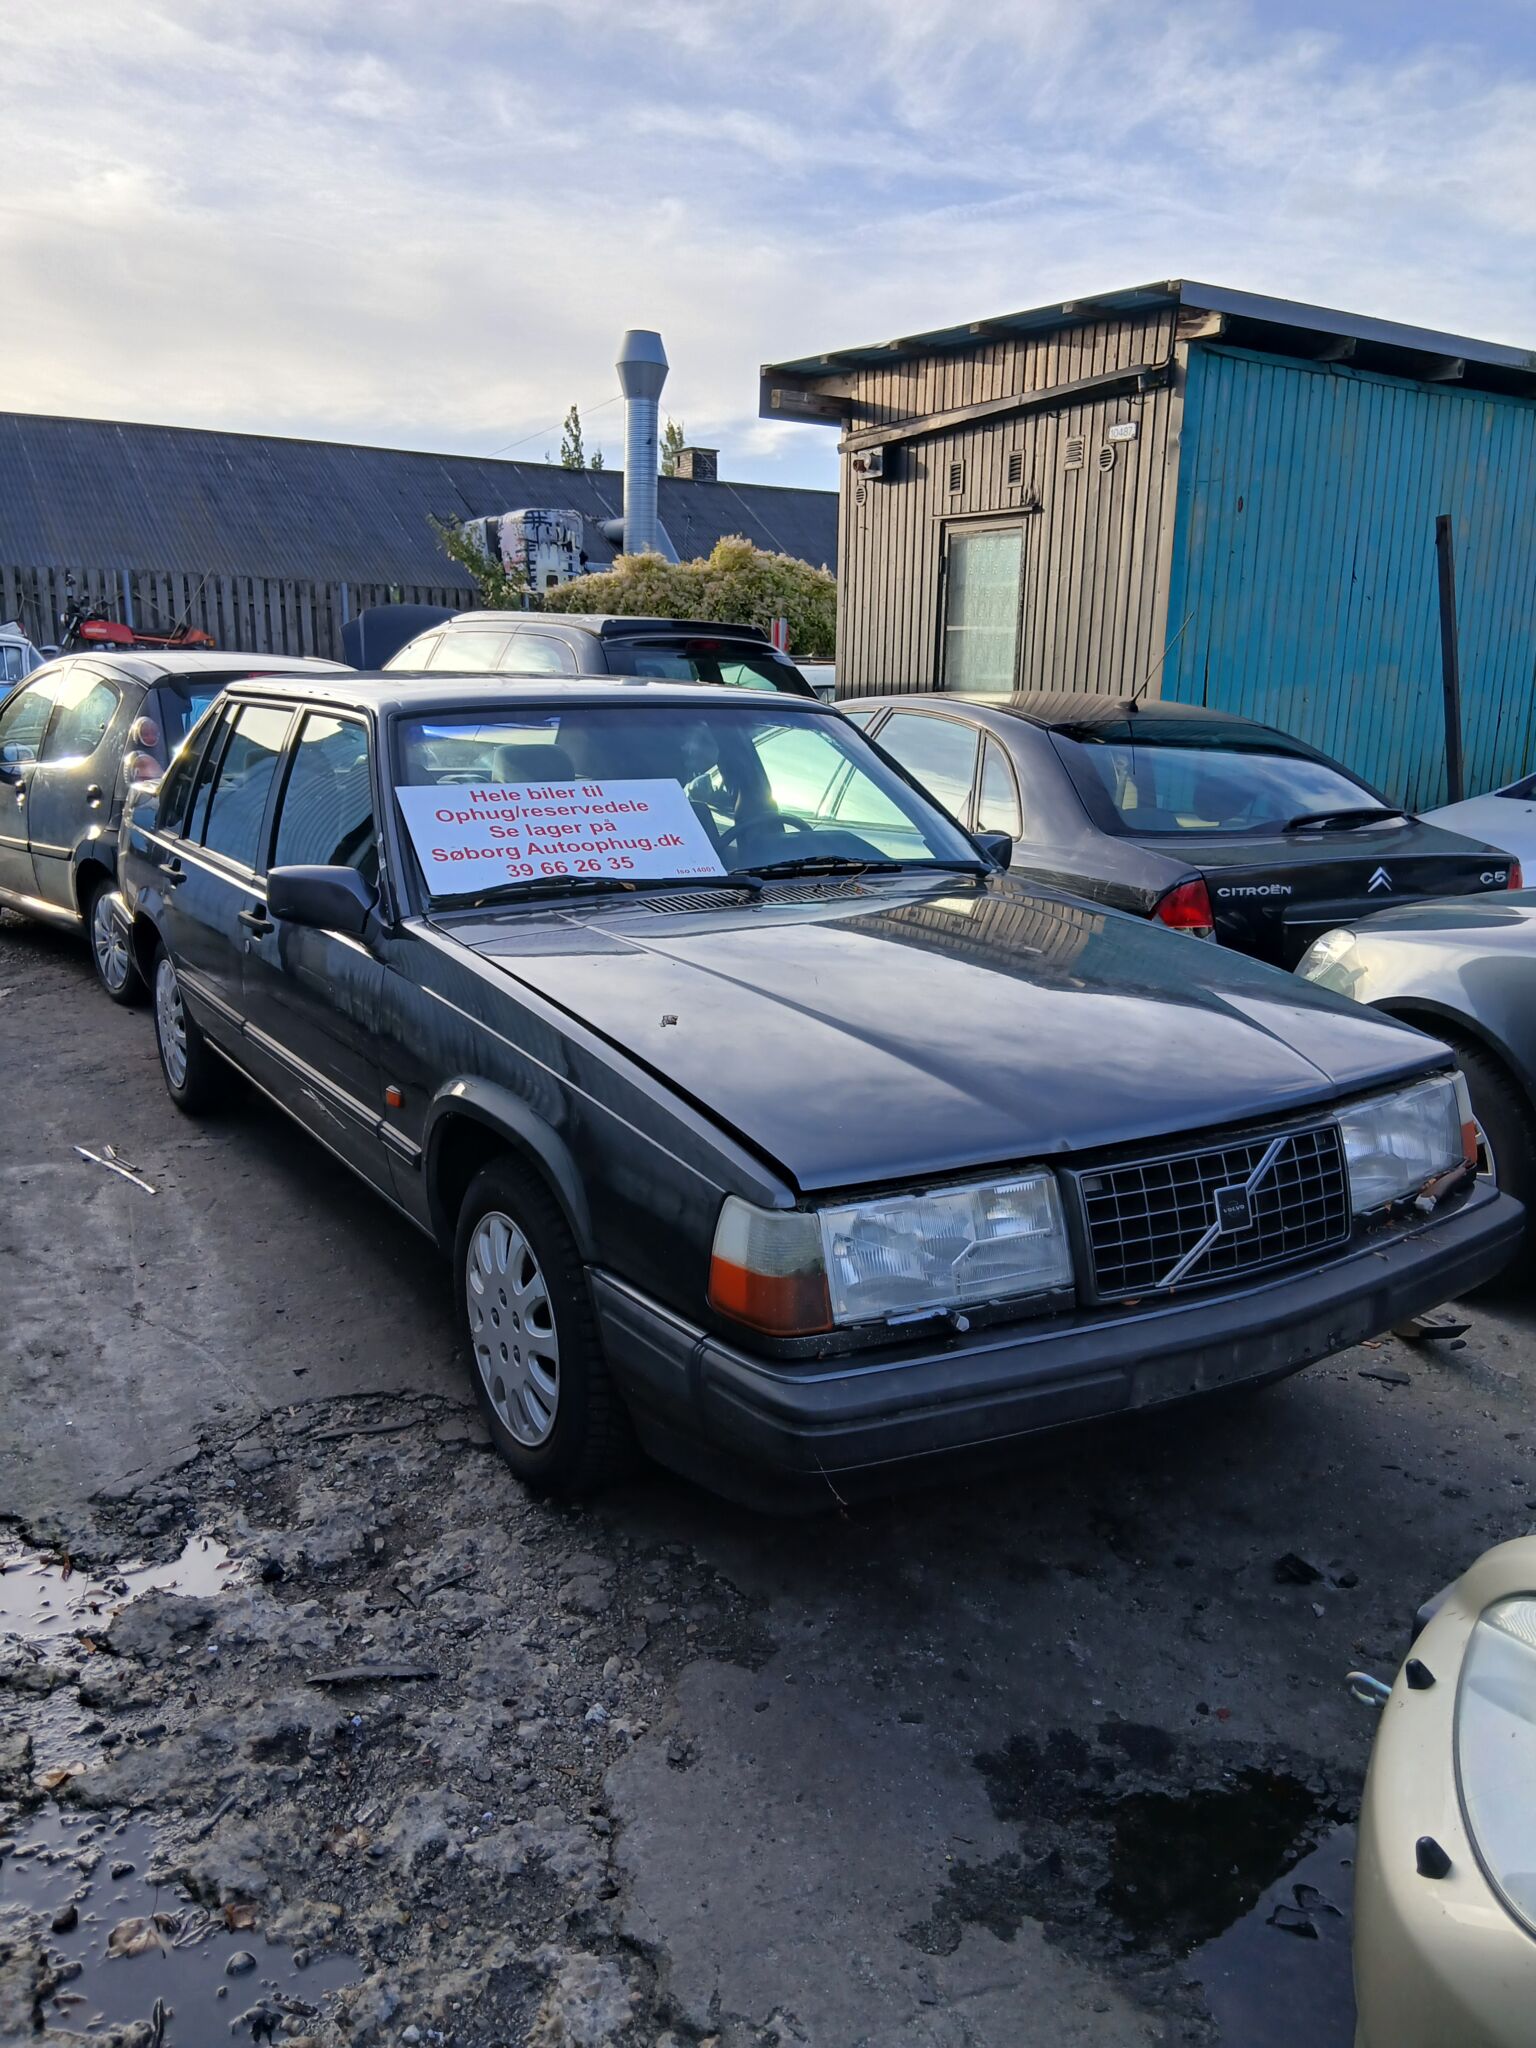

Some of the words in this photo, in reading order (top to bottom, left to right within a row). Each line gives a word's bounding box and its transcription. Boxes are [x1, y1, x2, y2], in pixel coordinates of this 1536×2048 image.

[470, 790, 521, 803] Hele
[527, 786, 576, 801] biler
[582, 784, 604, 798] til
[435, 799, 649, 823] Ophug/reservedele
[489, 825, 519, 839] Se
[526, 822, 581, 839] lager
[589, 818, 617, 836] på
[431, 845, 521, 863] Søborg
[527, 833, 684, 857] Autoophug.dk
[506, 864, 534, 877] 39
[540, 860, 568, 875] 66
[573, 858, 602, 873] 26
[608, 856, 635, 869] 35
[1480, 870, 1506, 884] C5
[1217, 884, 1291, 897] CITROËN
[1223, 1204, 1245, 1213] VOLVO
